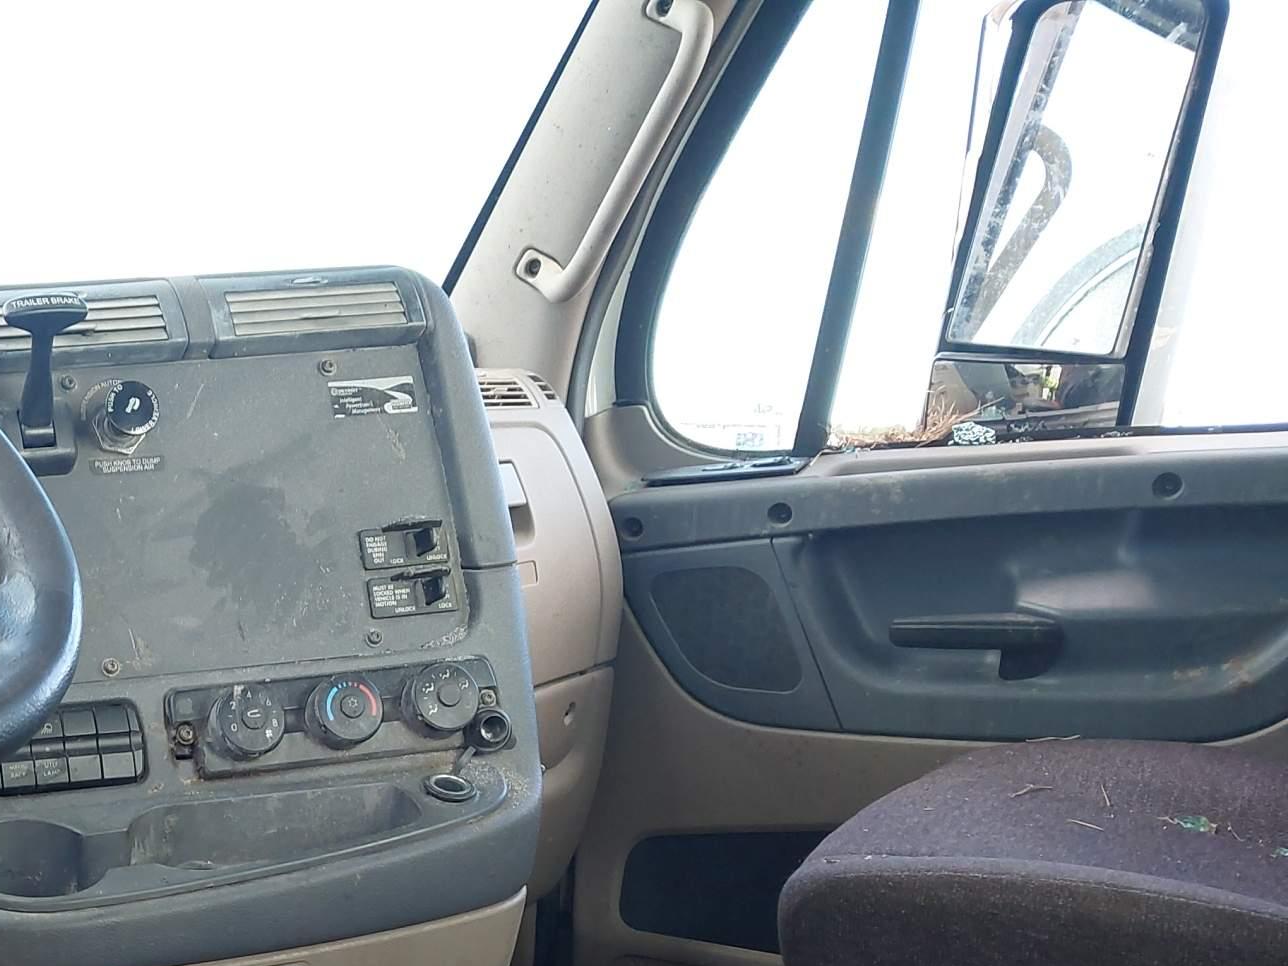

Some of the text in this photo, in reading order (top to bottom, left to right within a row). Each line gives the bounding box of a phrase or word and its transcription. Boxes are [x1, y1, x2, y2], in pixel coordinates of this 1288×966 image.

[12, 296, 81, 309] TRAILER BRAKE
[107, 391, 116, 412] PUSH
[113, 383, 123, 393] TO
[94, 460, 112, 468] PUSH
[142, 456, 161, 464] DUMP
[102, 462, 155, 473] SUSPENSION AIR
[246, 690, 252, 698] 4
[230, 701, 236, 710] 2
[265, 697, 272, 706] 6
[230, 722, 238, 732] 0
[272, 718, 279, 728] 8
